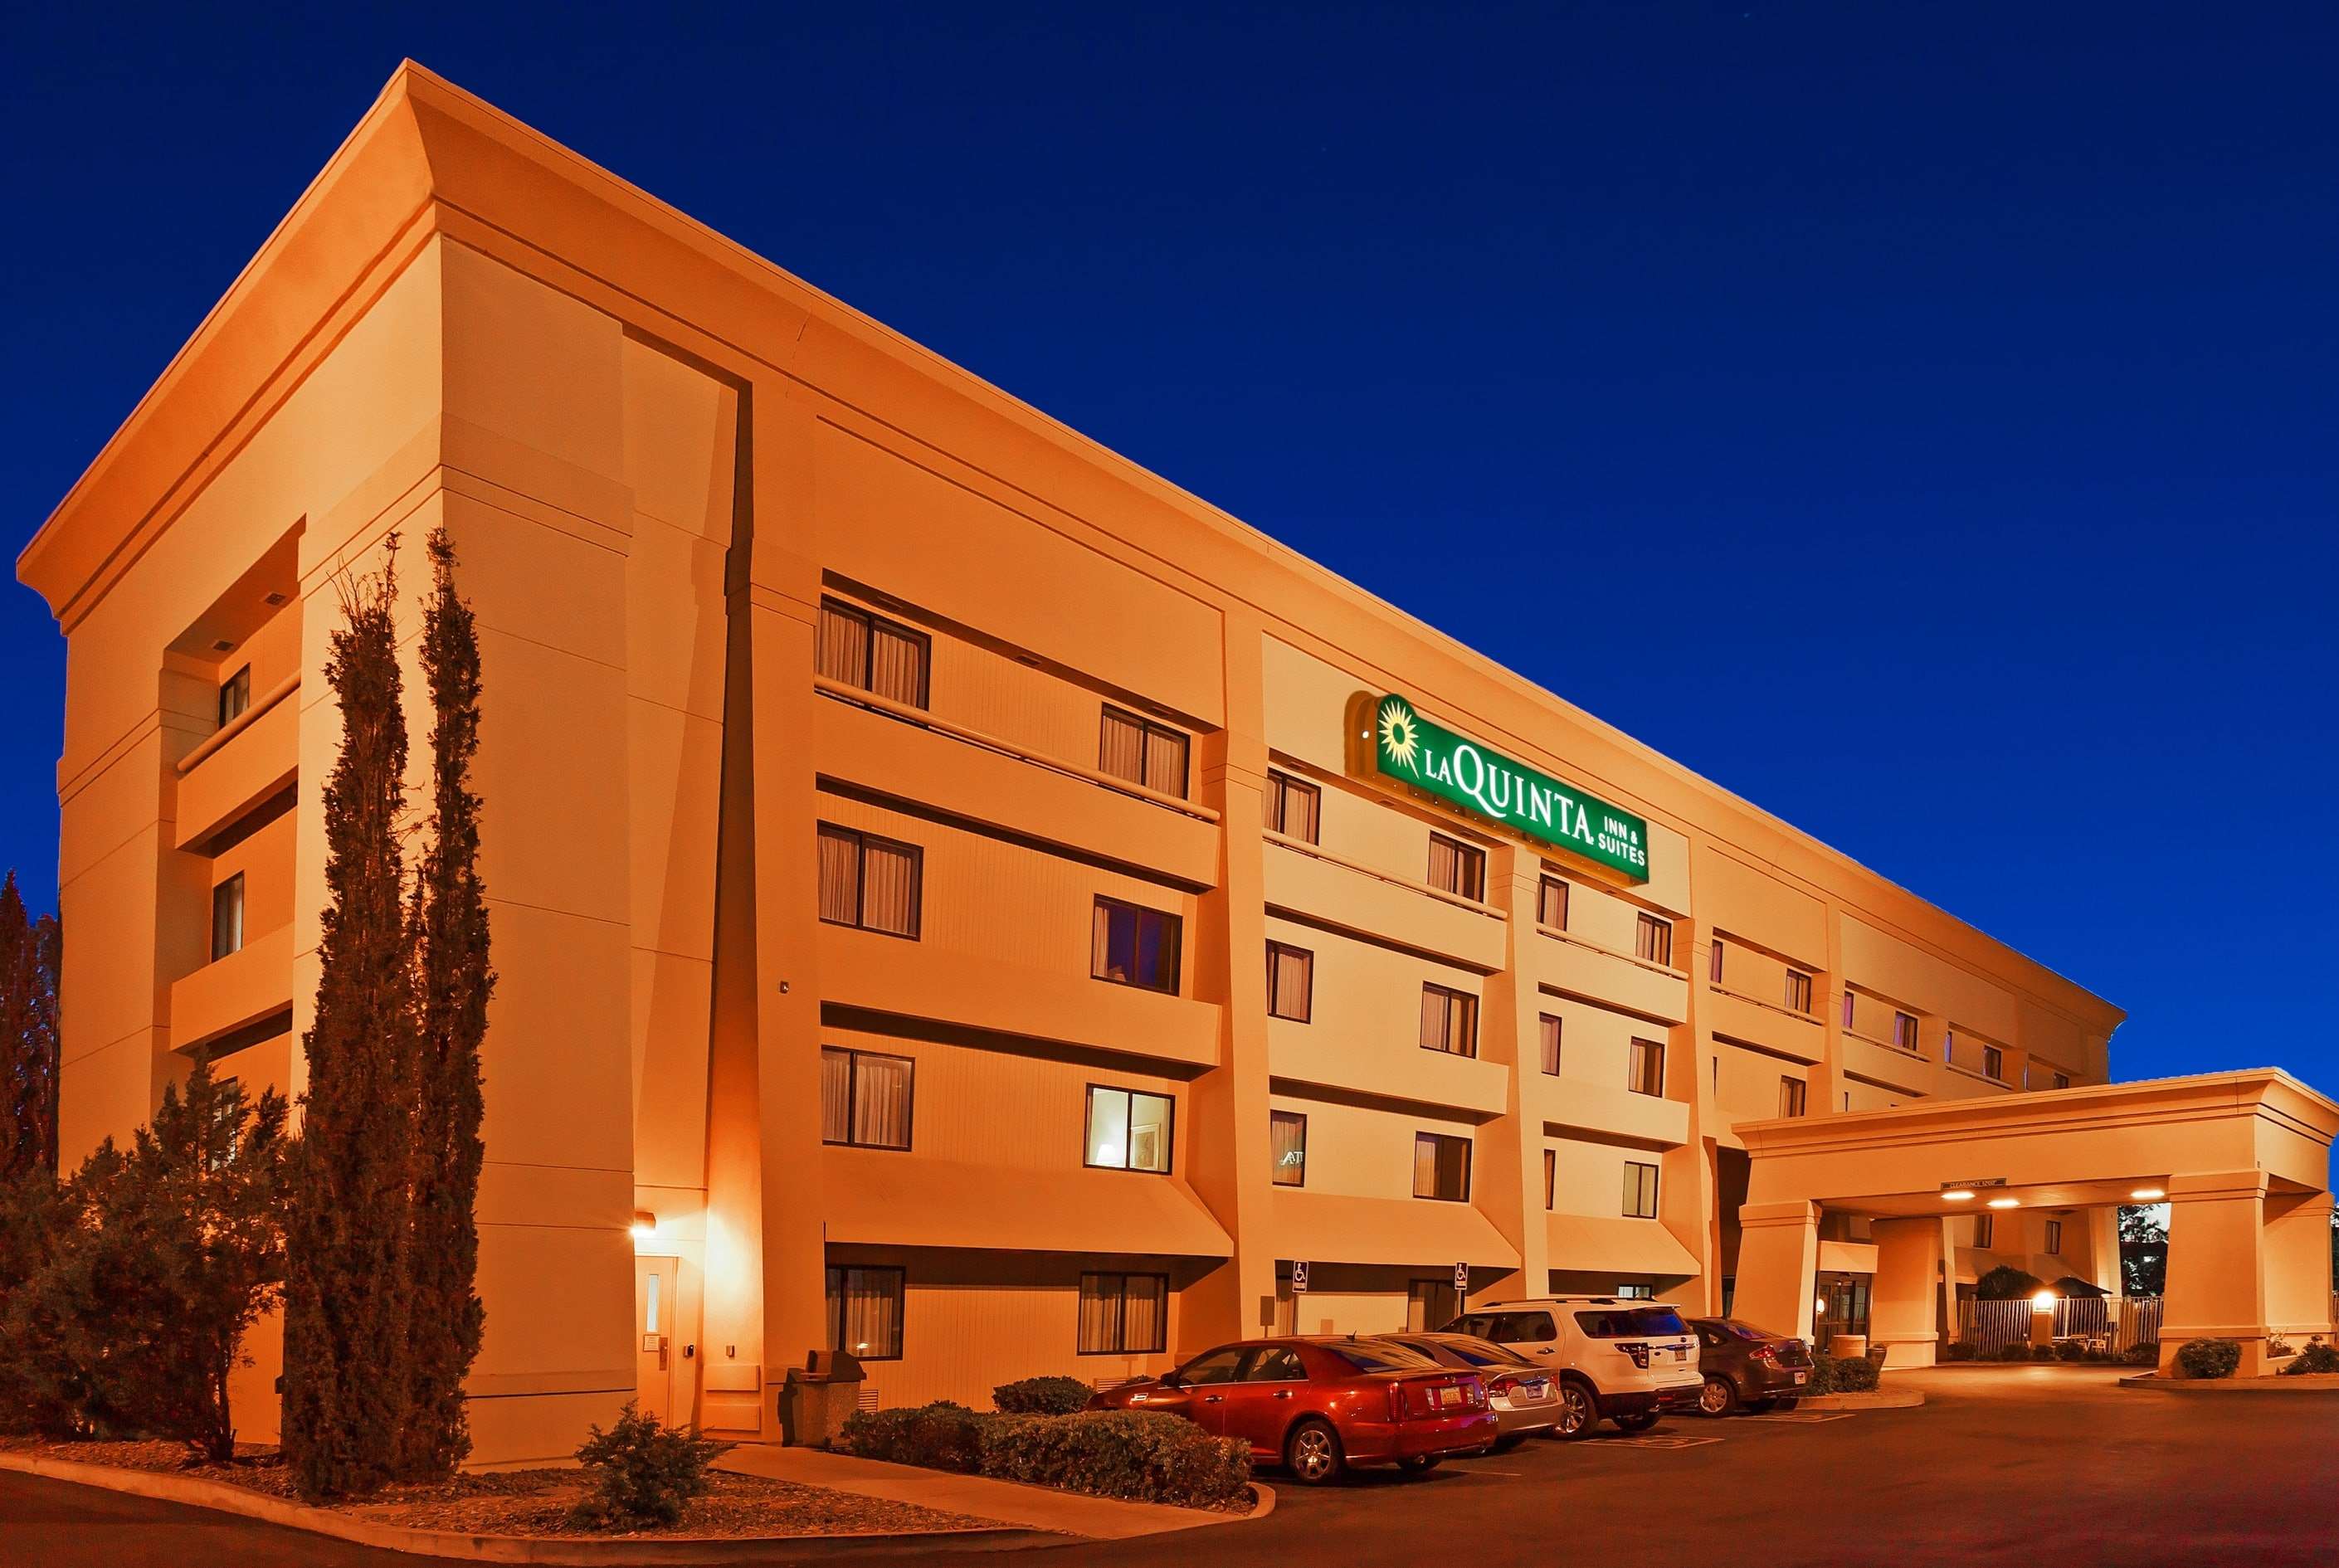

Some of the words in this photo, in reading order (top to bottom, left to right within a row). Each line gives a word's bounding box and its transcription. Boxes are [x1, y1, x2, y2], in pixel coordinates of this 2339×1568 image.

[1425, 748, 1454, 786] LA
[1454, 744, 1595, 845] QUINTA
[1604, 816, 1628, 840] INN
[1630, 830, 1639, 845] &
[1598, 832, 1645, 866] SUITES
